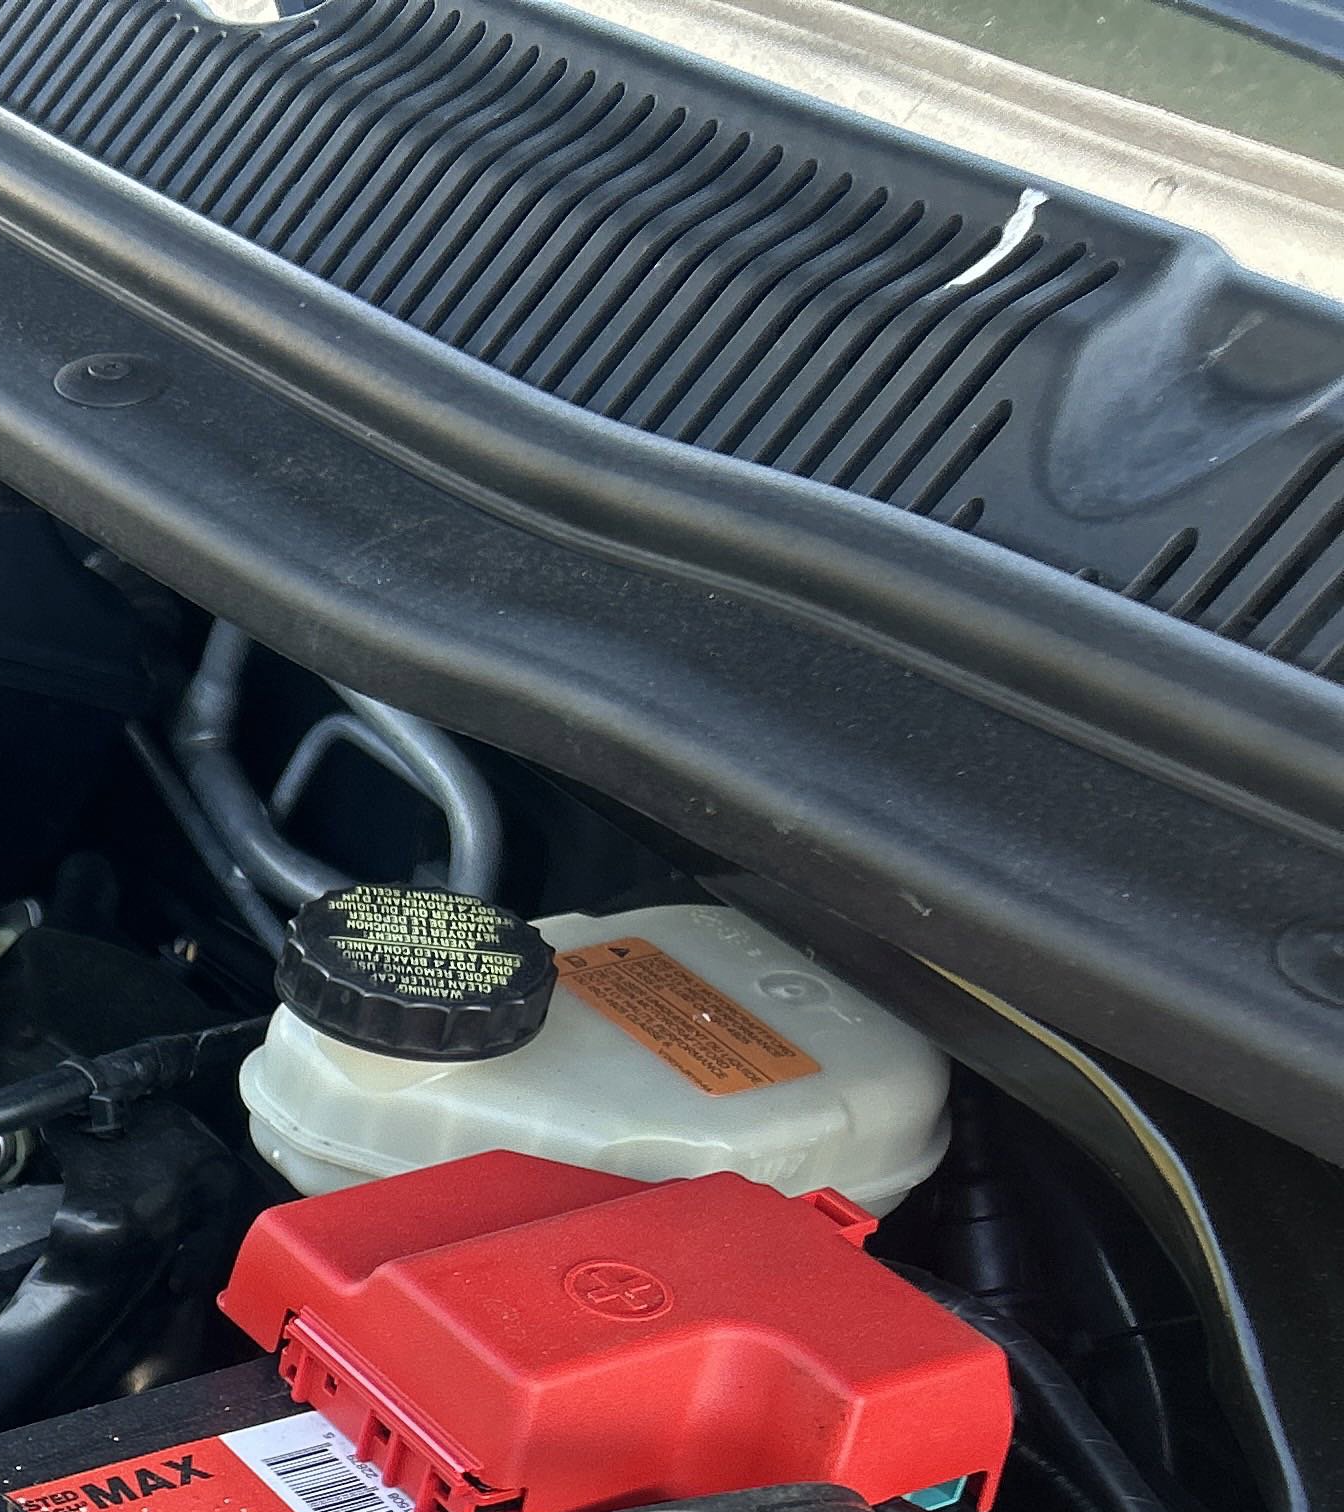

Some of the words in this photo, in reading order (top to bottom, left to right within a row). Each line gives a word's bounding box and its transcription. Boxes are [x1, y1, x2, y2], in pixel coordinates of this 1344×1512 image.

[374, 895, 453, 911] PROVENANT
[404, 890, 481, 905] CONTENANT
[327, 899, 377, 912] LIQUIDE
[379, 904, 398, 914] DU
[401, 906, 428, 918] QUE
[456, 904, 467, 912] 4
[469, 905, 496, 915] DOT
[345, 918, 407, 933] BOUCHON
[409, 916, 426, 927] LE
[428, 917, 447, 928] DE
[449, 920, 495, 932] AVANT
[410, 925, 427, 936] LE
[429, 927, 500, 943] NETTOYER
[341, 949, 379, 962] FLUID
[383, 953, 427, 966] BRAKE
[413, 947, 464, 961] SEALED
[467, 952, 477, 962] A
[480, 953, 521, 967] FROM
[433, 959, 444, 967] 4
[448, 960, 475, 971] DOT
[479, 963, 513, 975] ONLY
[399, 974, 444, 988] FILLER
[455, 969, 508, 985] BEFORE
[447, 979, 491, 993] CLEAN
[80, 1454, 216, 1510] MAX
